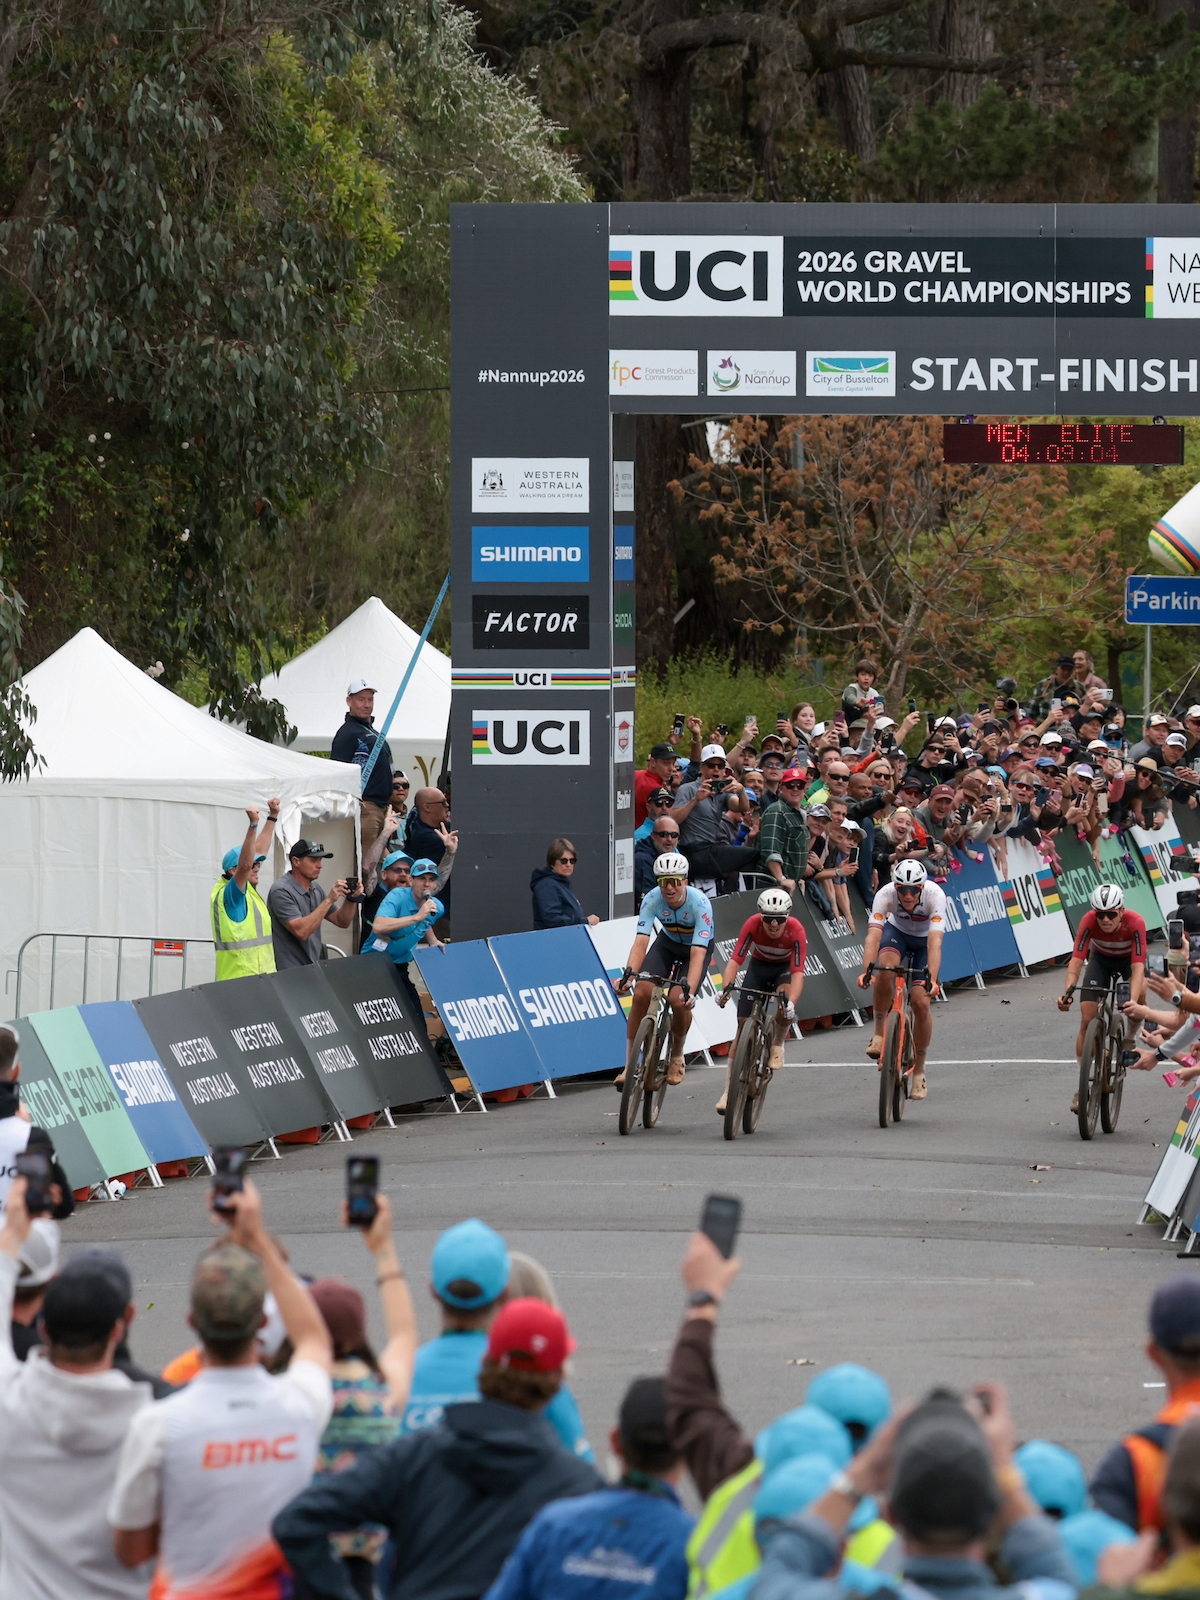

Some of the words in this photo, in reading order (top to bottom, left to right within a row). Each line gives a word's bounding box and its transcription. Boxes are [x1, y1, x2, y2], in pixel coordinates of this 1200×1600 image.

[639, 250, 769, 302] UCI
[797, 251, 857, 273] 2026
[864, 251, 971, 273] GRAVEL
[796, 281, 897, 303] WORLD
[903, 281, 1132, 304] CHAMPIONSHIPS
[477, 368, 586, 387] #Nannup2026
[612, 360, 642, 386] fpc
[644, 367, 665, 375] Forest
[667, 367, 696, 375] Products
[744, 373, 791, 386] Nannup
[813, 374, 832, 385] City
[833, 374, 843, 384] of
[845, 374, 889, 384] Busselton
[909, 358, 1198, 392] START-FINISH
[987, 424, 1030, 443] MEN
[1061, 424, 1134, 443] ELITE
[1001, 444, 1119, 463] 04:09:04
[519, 481, 583, 490] AUSTRALIA
[523, 471, 579, 479] WESTERN
[480, 546, 581, 562] SHIMANO
[484, 611, 579, 633] FACTOR
[515, 673, 547, 686] UCI
[493, 720, 580, 755] UCI
[960, 885, 1007, 927] SHIMANO
[1012, 873, 1046, 921] UCI
[353, 996, 404, 1025] WESTERN
[518, 977, 618, 1028] SHIMANO
[299, 1009, 339, 1039] WESTERN
[442, 993, 520, 1042] SHIMANO
[230, 1021, 284, 1052] WESTERN
[367, 1030, 423, 1061] AUSTRALIA
[169, 1035, 218, 1068] WESTERN
[316, 1044, 360, 1075] AUSTRALIA
[109, 1059, 177, 1107] SHIMANO
[246, 1056, 305, 1089] AUSTRALIA
[186, 1071, 240, 1106] AUSTRALIA
